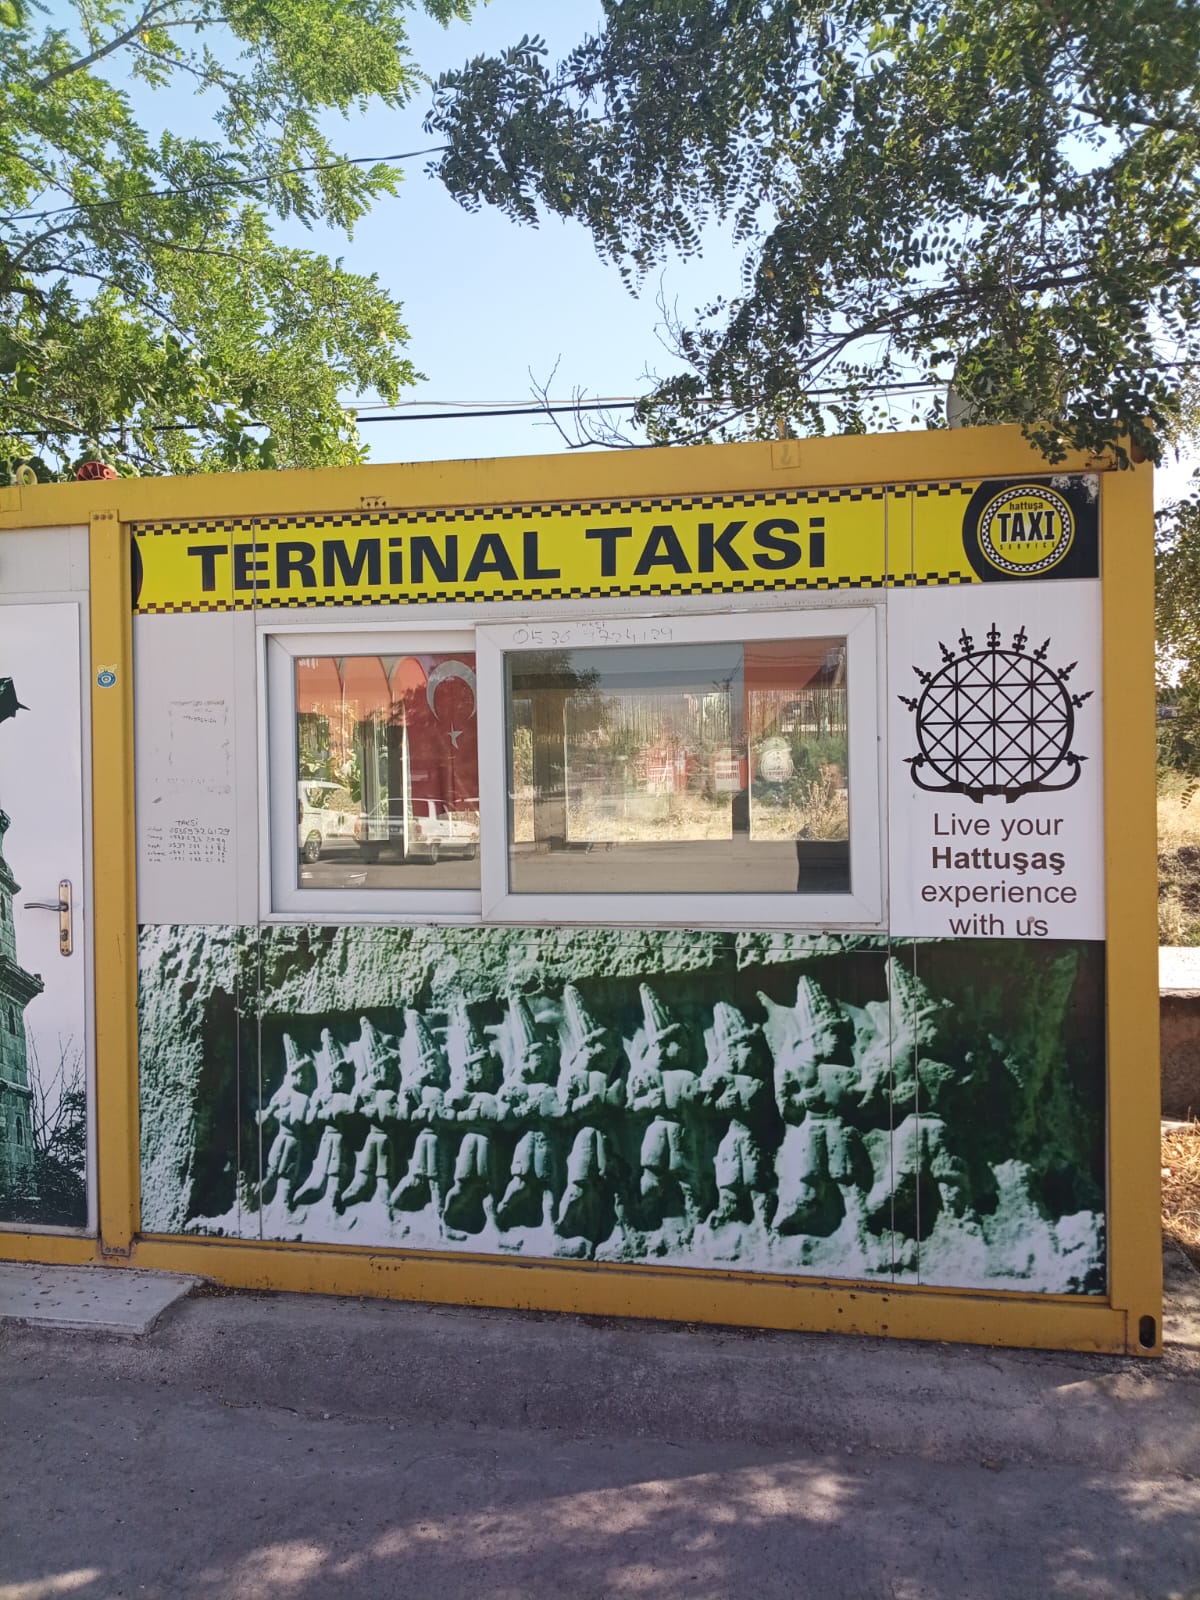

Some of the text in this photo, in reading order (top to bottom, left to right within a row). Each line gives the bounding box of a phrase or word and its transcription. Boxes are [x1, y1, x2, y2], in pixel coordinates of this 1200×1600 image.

[997, 511, 1055, 542] TAXI
[585, 517, 825, 577] TAKSi
[934, 813, 1064, 842] Live your
[932, 846, 1066, 876] Hattuşaş
[921, 880, 1077, 908] experience
[949, 913, 1049, 936] with us
